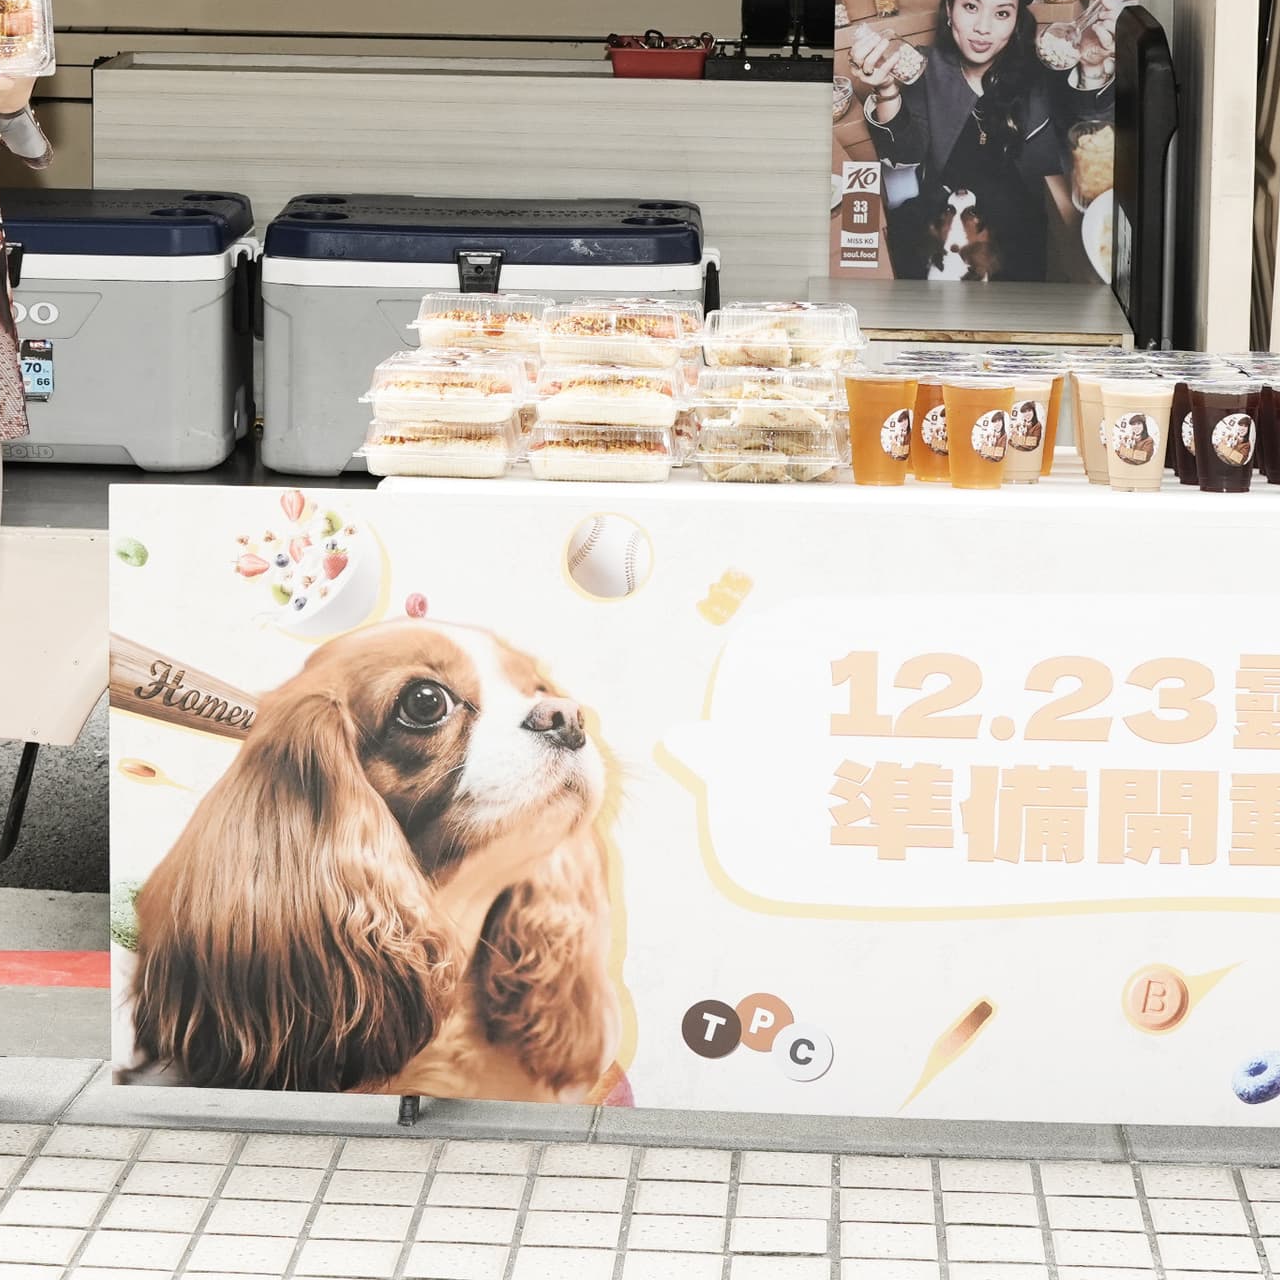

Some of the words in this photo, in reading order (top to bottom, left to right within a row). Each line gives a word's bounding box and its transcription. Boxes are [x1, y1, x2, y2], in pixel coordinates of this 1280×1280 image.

[853, 200, 868, 213] 33
[853, 212, 868, 224] ml
[847, 237, 863, 245] MISS
[864, 237, 874, 245] KO
[25, 363, 42, 373] 70
[36, 378, 50, 386] 66
[702, 1007, 816, 1068] TPC
